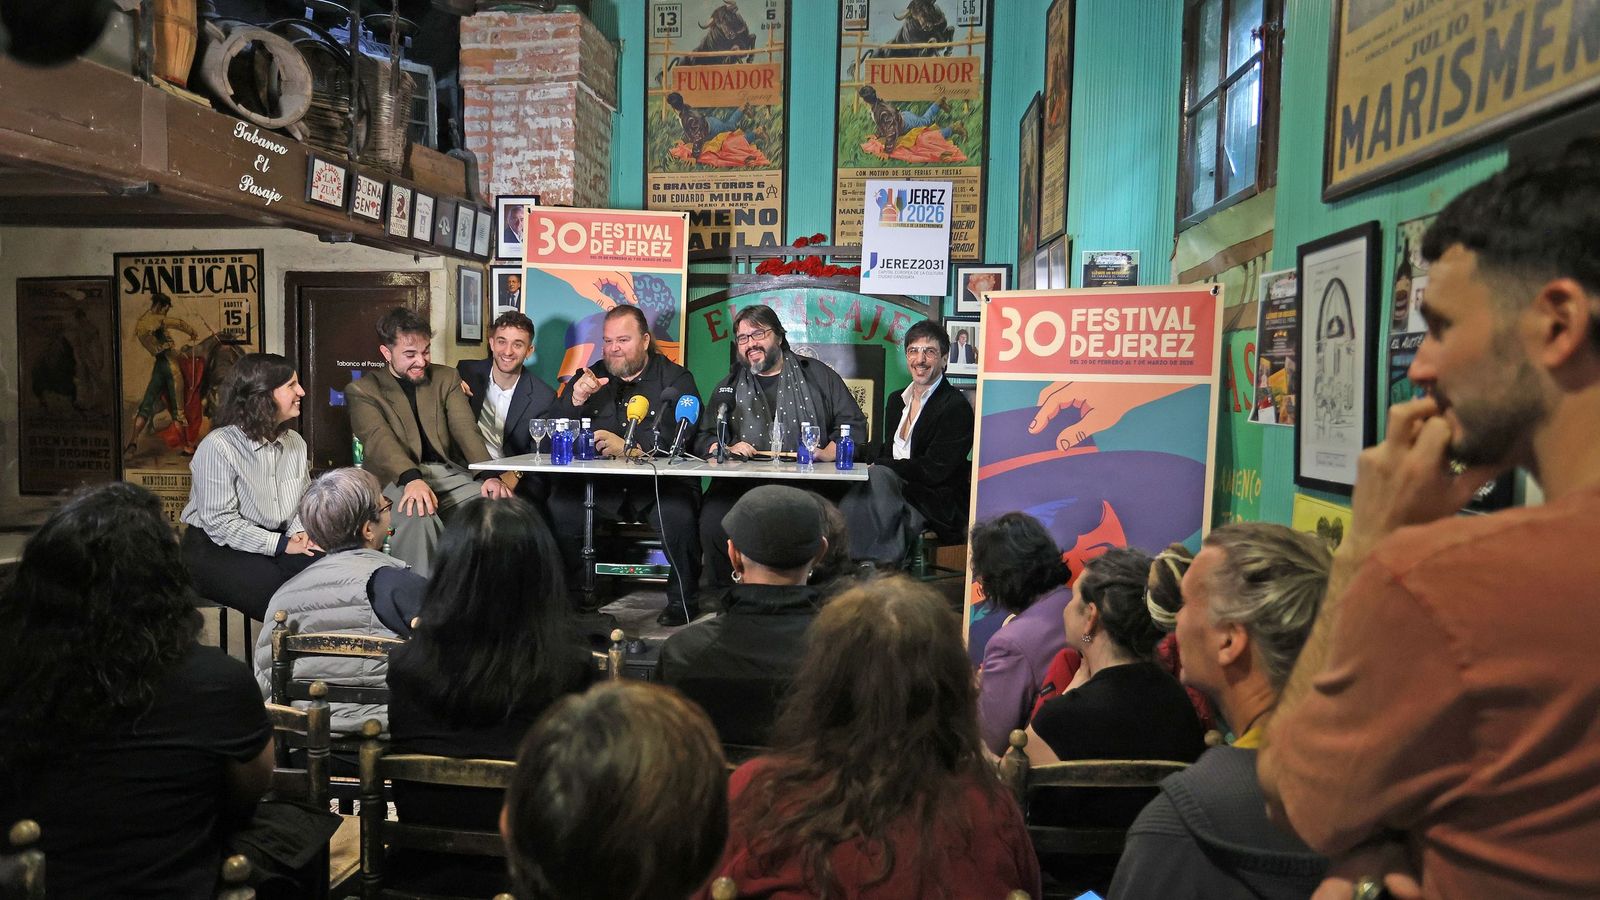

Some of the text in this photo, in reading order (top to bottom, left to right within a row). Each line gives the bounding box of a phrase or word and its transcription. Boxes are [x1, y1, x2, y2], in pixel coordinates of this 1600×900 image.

[659, 12, 677, 26] 13
[766, 9, 776, 20] 6
[1404, 13, 1469, 65] JULIO
[677, 69, 774, 91] FUNDADOR
[870, 62, 974, 85] FUNDADOR
[233, 121, 288, 156] Tabanco
[254, 154, 270, 173] El
[238, 174, 283, 206] Pasaje
[663, 182, 711, 190] BRAVOS
[714, 181, 753, 189] TOROS
[652, 192, 765, 203] DON EDUARDO MIURA
[908, 188, 946, 205] JEREZ
[687, 207, 778, 226] MEÑO
[907, 205, 944, 223] 2026
[538, 217, 587, 256] 30
[590, 221, 673, 241] FESTIVAL
[688, 231, 778, 249] AULA
[590, 239, 672, 257] DE JEREZ
[879, 259, 944, 270] JEREZ2031
[123, 264, 257, 294] SANLUCAR
[224, 310, 241, 326] 15
[1071, 306, 1196, 332] FESTIVAL
[998, 306, 1066, 361] 30
[1070, 333, 1195, 358] DE JEREZ
